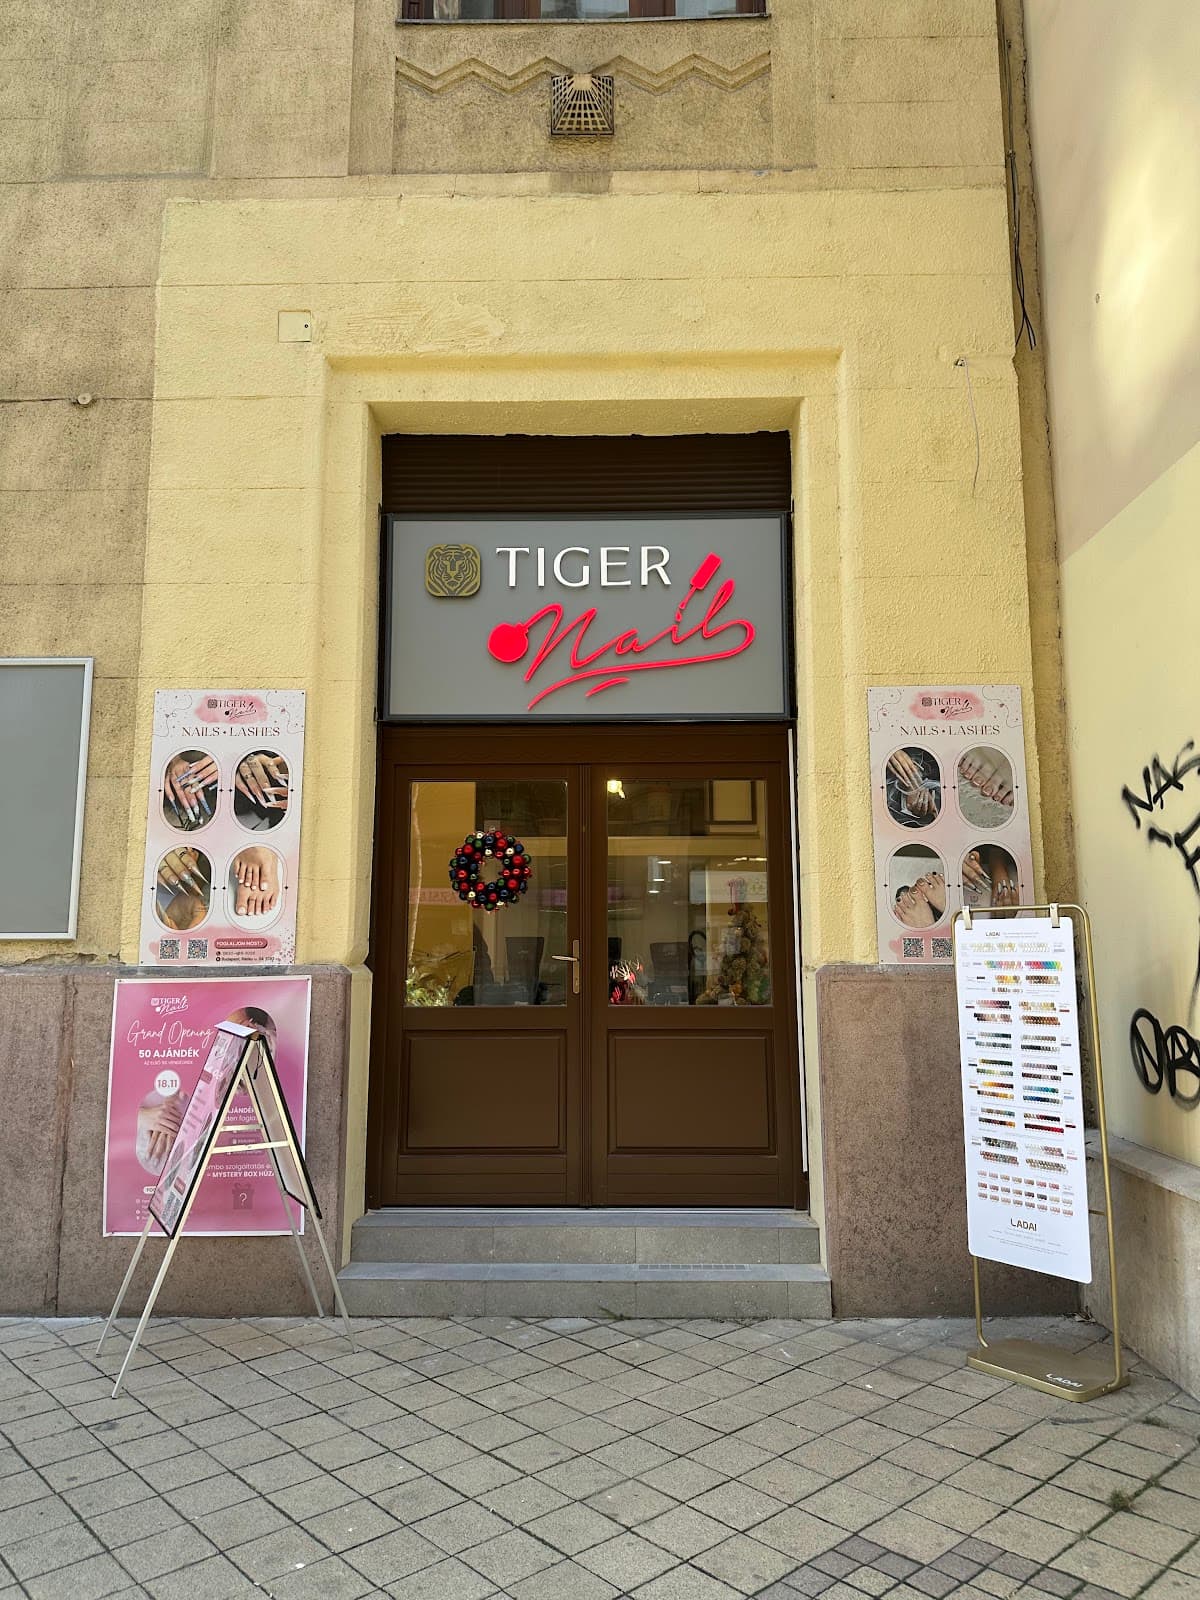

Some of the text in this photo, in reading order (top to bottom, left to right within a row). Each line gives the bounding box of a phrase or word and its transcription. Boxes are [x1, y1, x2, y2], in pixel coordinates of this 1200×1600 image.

[495, 545, 672, 588] TIGER
[488, 552, 755, 711] Nail
[219, 699, 246, 708] TIGER
[931, 697, 961, 706] TIGER
[181, 726, 281, 737] NAILS LASHES
[900, 724, 1001, 736] NAILS LASHES
[159, 997, 181, 1005] TIGER
[127, 1020, 167, 1047] Grand
[168, 1020, 215, 1049] Opening
[138, 1047, 200, 1058] 50 AJÁNDÉK
[157, 1079, 178, 1088] 18.11
[227, 1105, 255, 1114] JÁNDÉ
[212, 1168, 275, 1178] MYSTERY BOX HÚZ
[1010, 1217, 1037, 1232] LADAI
[1045, 1373, 1084, 1388] LADAI
